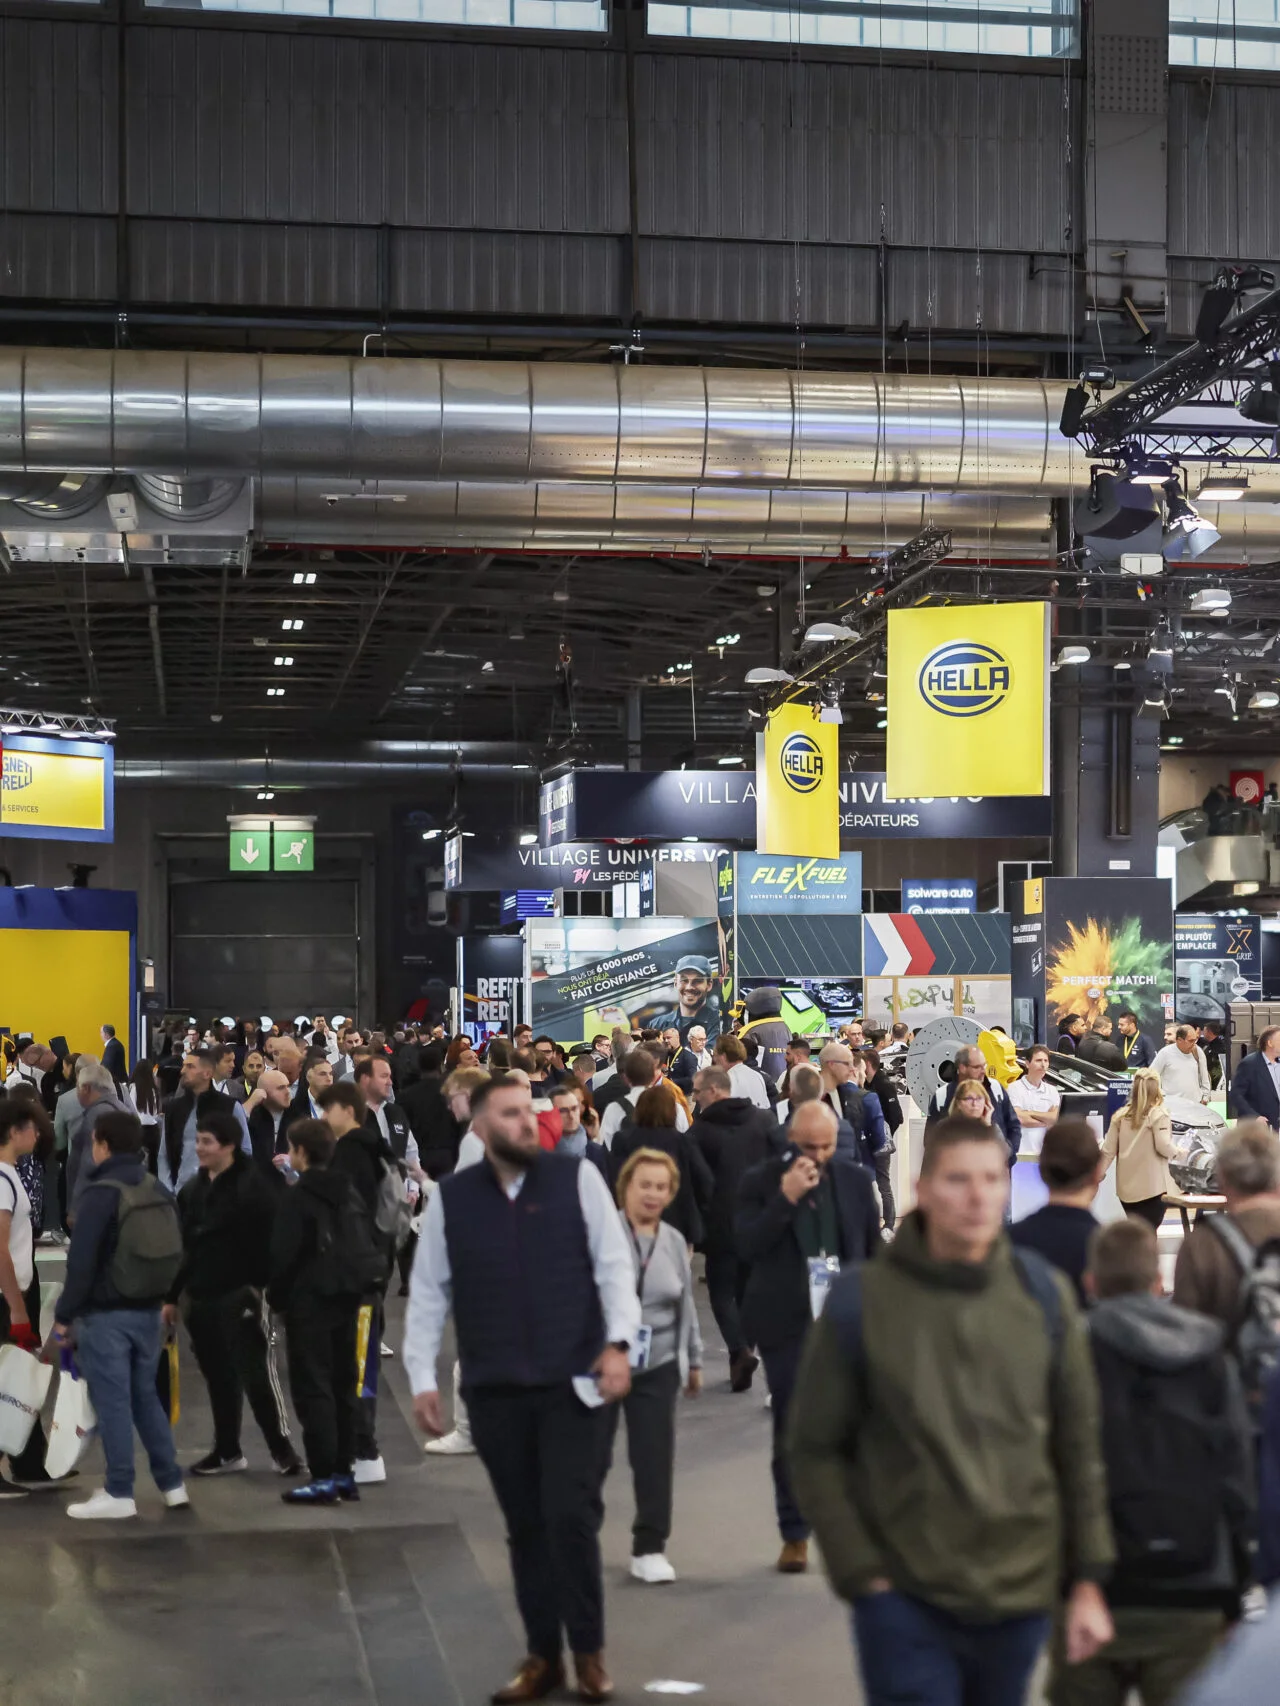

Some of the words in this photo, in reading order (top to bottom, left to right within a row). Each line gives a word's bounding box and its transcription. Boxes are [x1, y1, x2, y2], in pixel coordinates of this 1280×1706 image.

[928, 666, 1009, 692] HELLA
[784, 753, 823, 775] HELLA
[679, 781, 757, 803] VILLA
[7, 804, 39, 813] SERVICES
[838, 813, 919, 827] DÉRATEURS
[518, 849, 600, 866] VILLAGE
[573, 868, 591, 885] BY
[592, 872, 611, 881] LES
[750, 858, 848, 894] FLEXFUEL
[907, 886, 949, 898] solware
[950, 887, 974, 898] auto
[1185, 931, 1213, 941] PLUTÔT
[1176, 942, 1217, 950] EMPLACER
[570, 971, 587, 983] PLUS
[622, 951, 646, 965] PROS
[557, 982, 578, 995] NOUS
[577, 978, 593, 988] ONT
[571, 987, 593, 1001] FAIT
[594, 963, 658, 993] CONFIANCE
[1062, 975, 1112, 985] PERFECT
[1116, 975, 1157, 985] MATCH!
